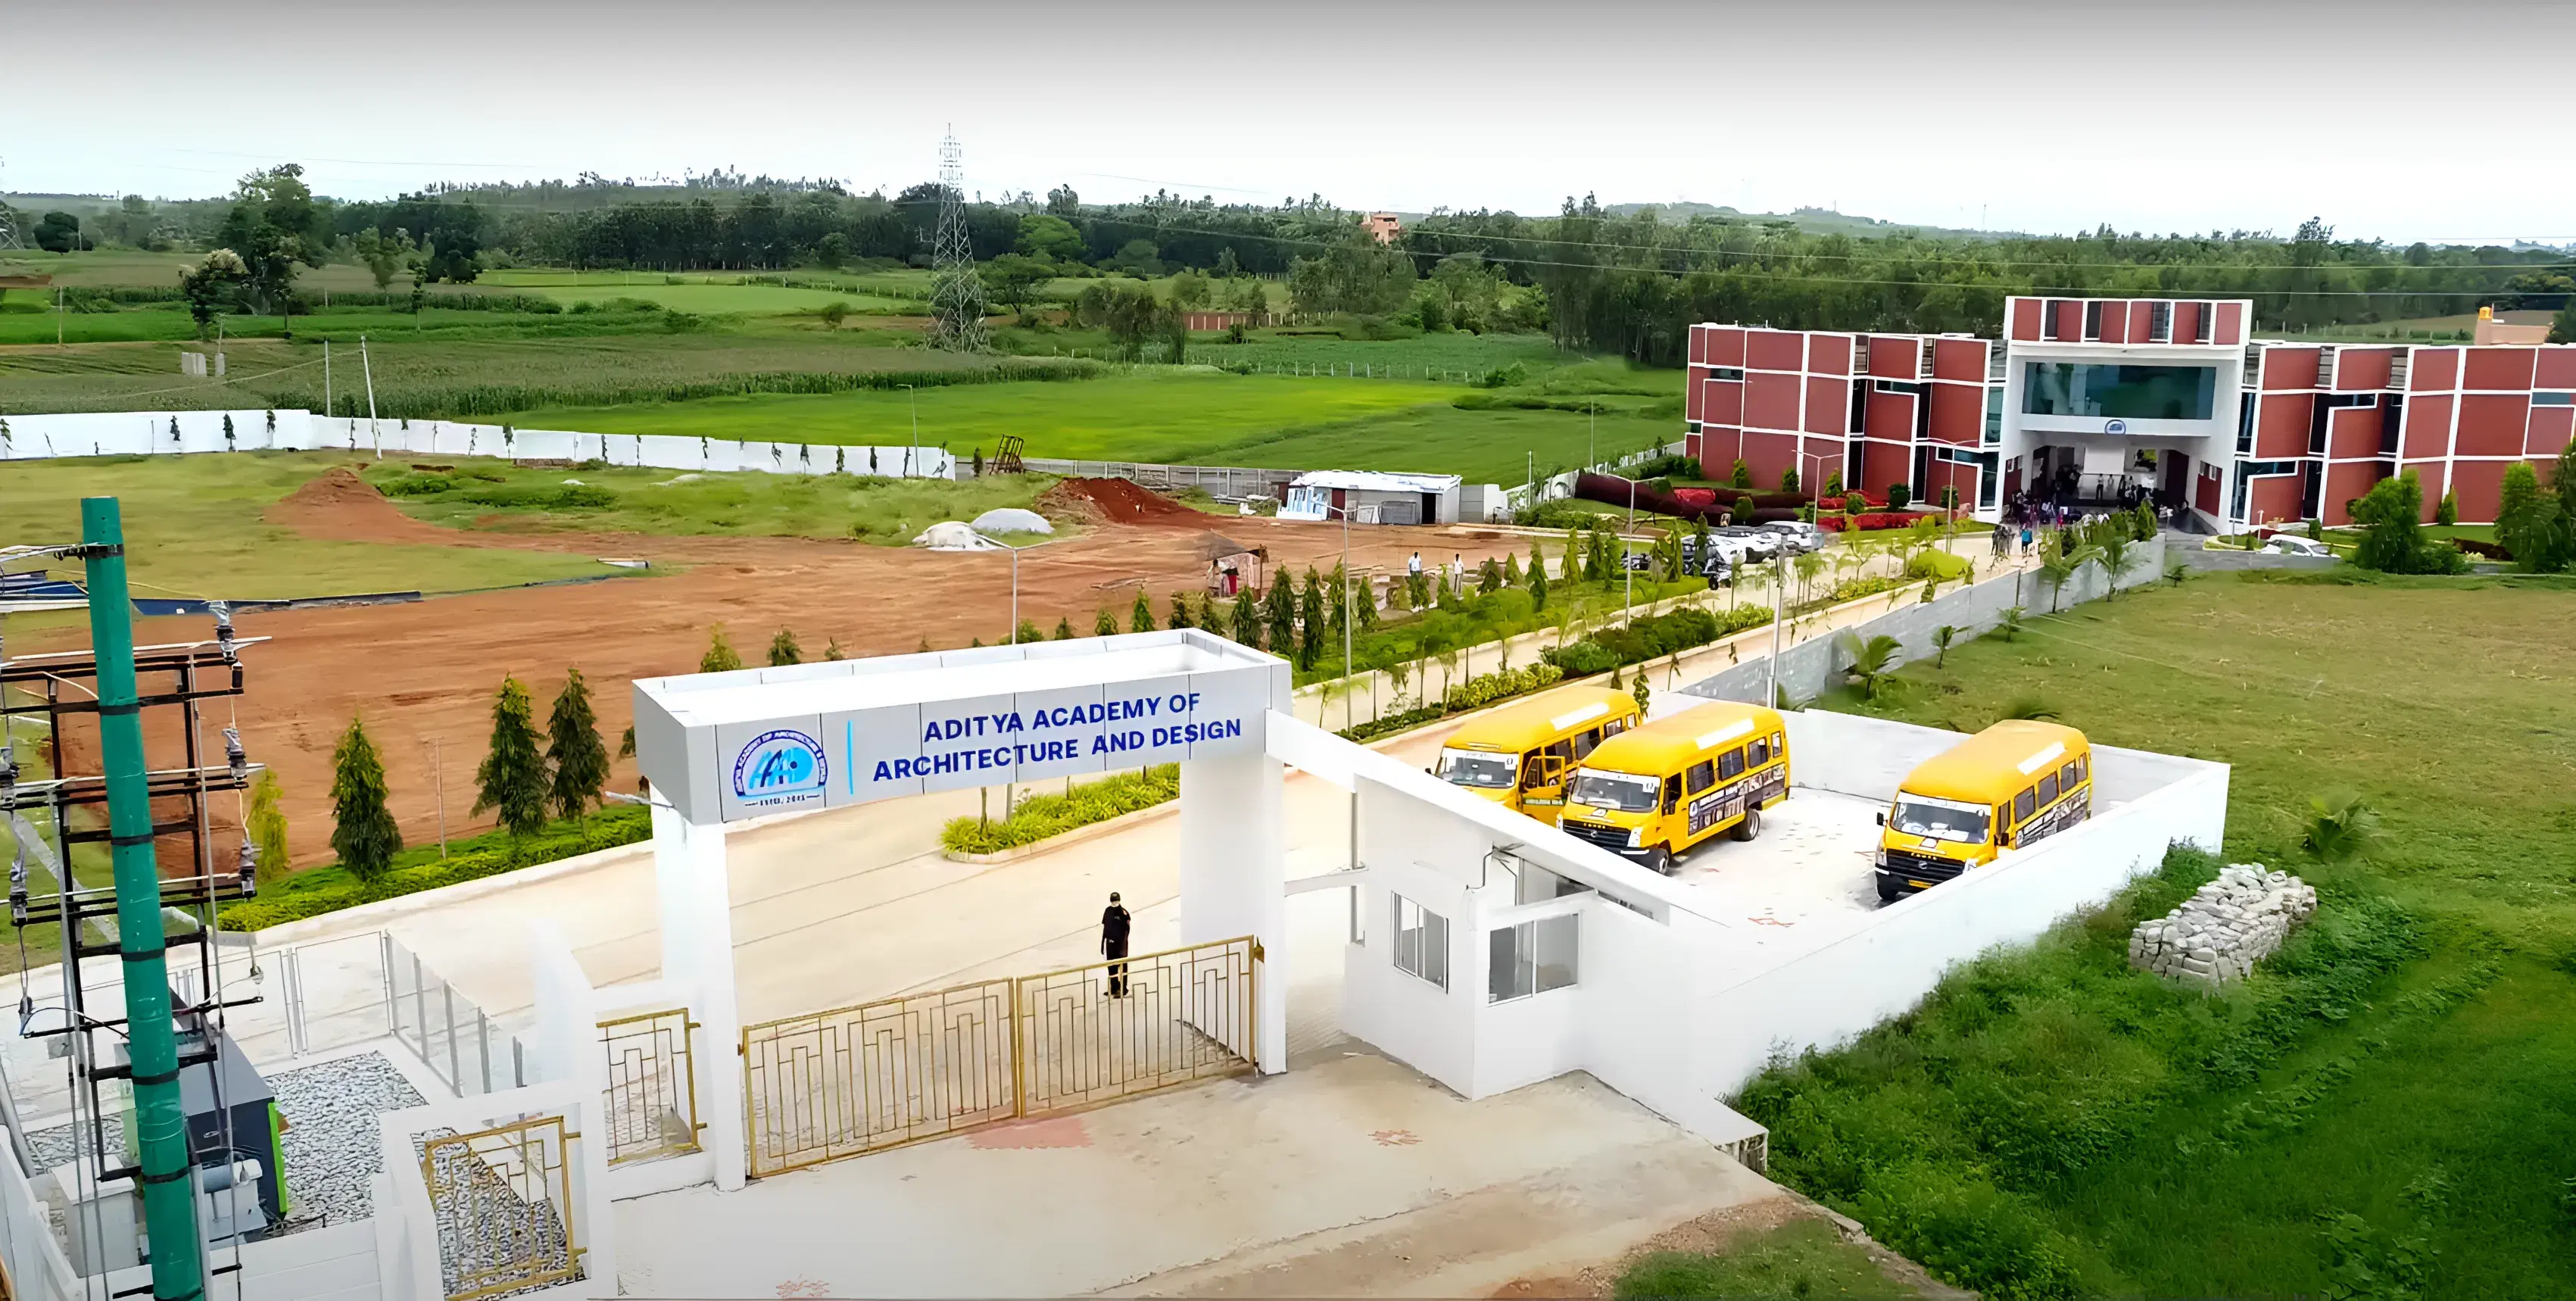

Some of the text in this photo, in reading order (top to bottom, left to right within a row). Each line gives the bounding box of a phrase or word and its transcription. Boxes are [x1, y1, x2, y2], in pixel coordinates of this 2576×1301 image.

[924, 693, 1200, 743] ADITYA ACADEMY OF
[873, 718, 1241, 782] ARCHITECTURE AND DESIGN
